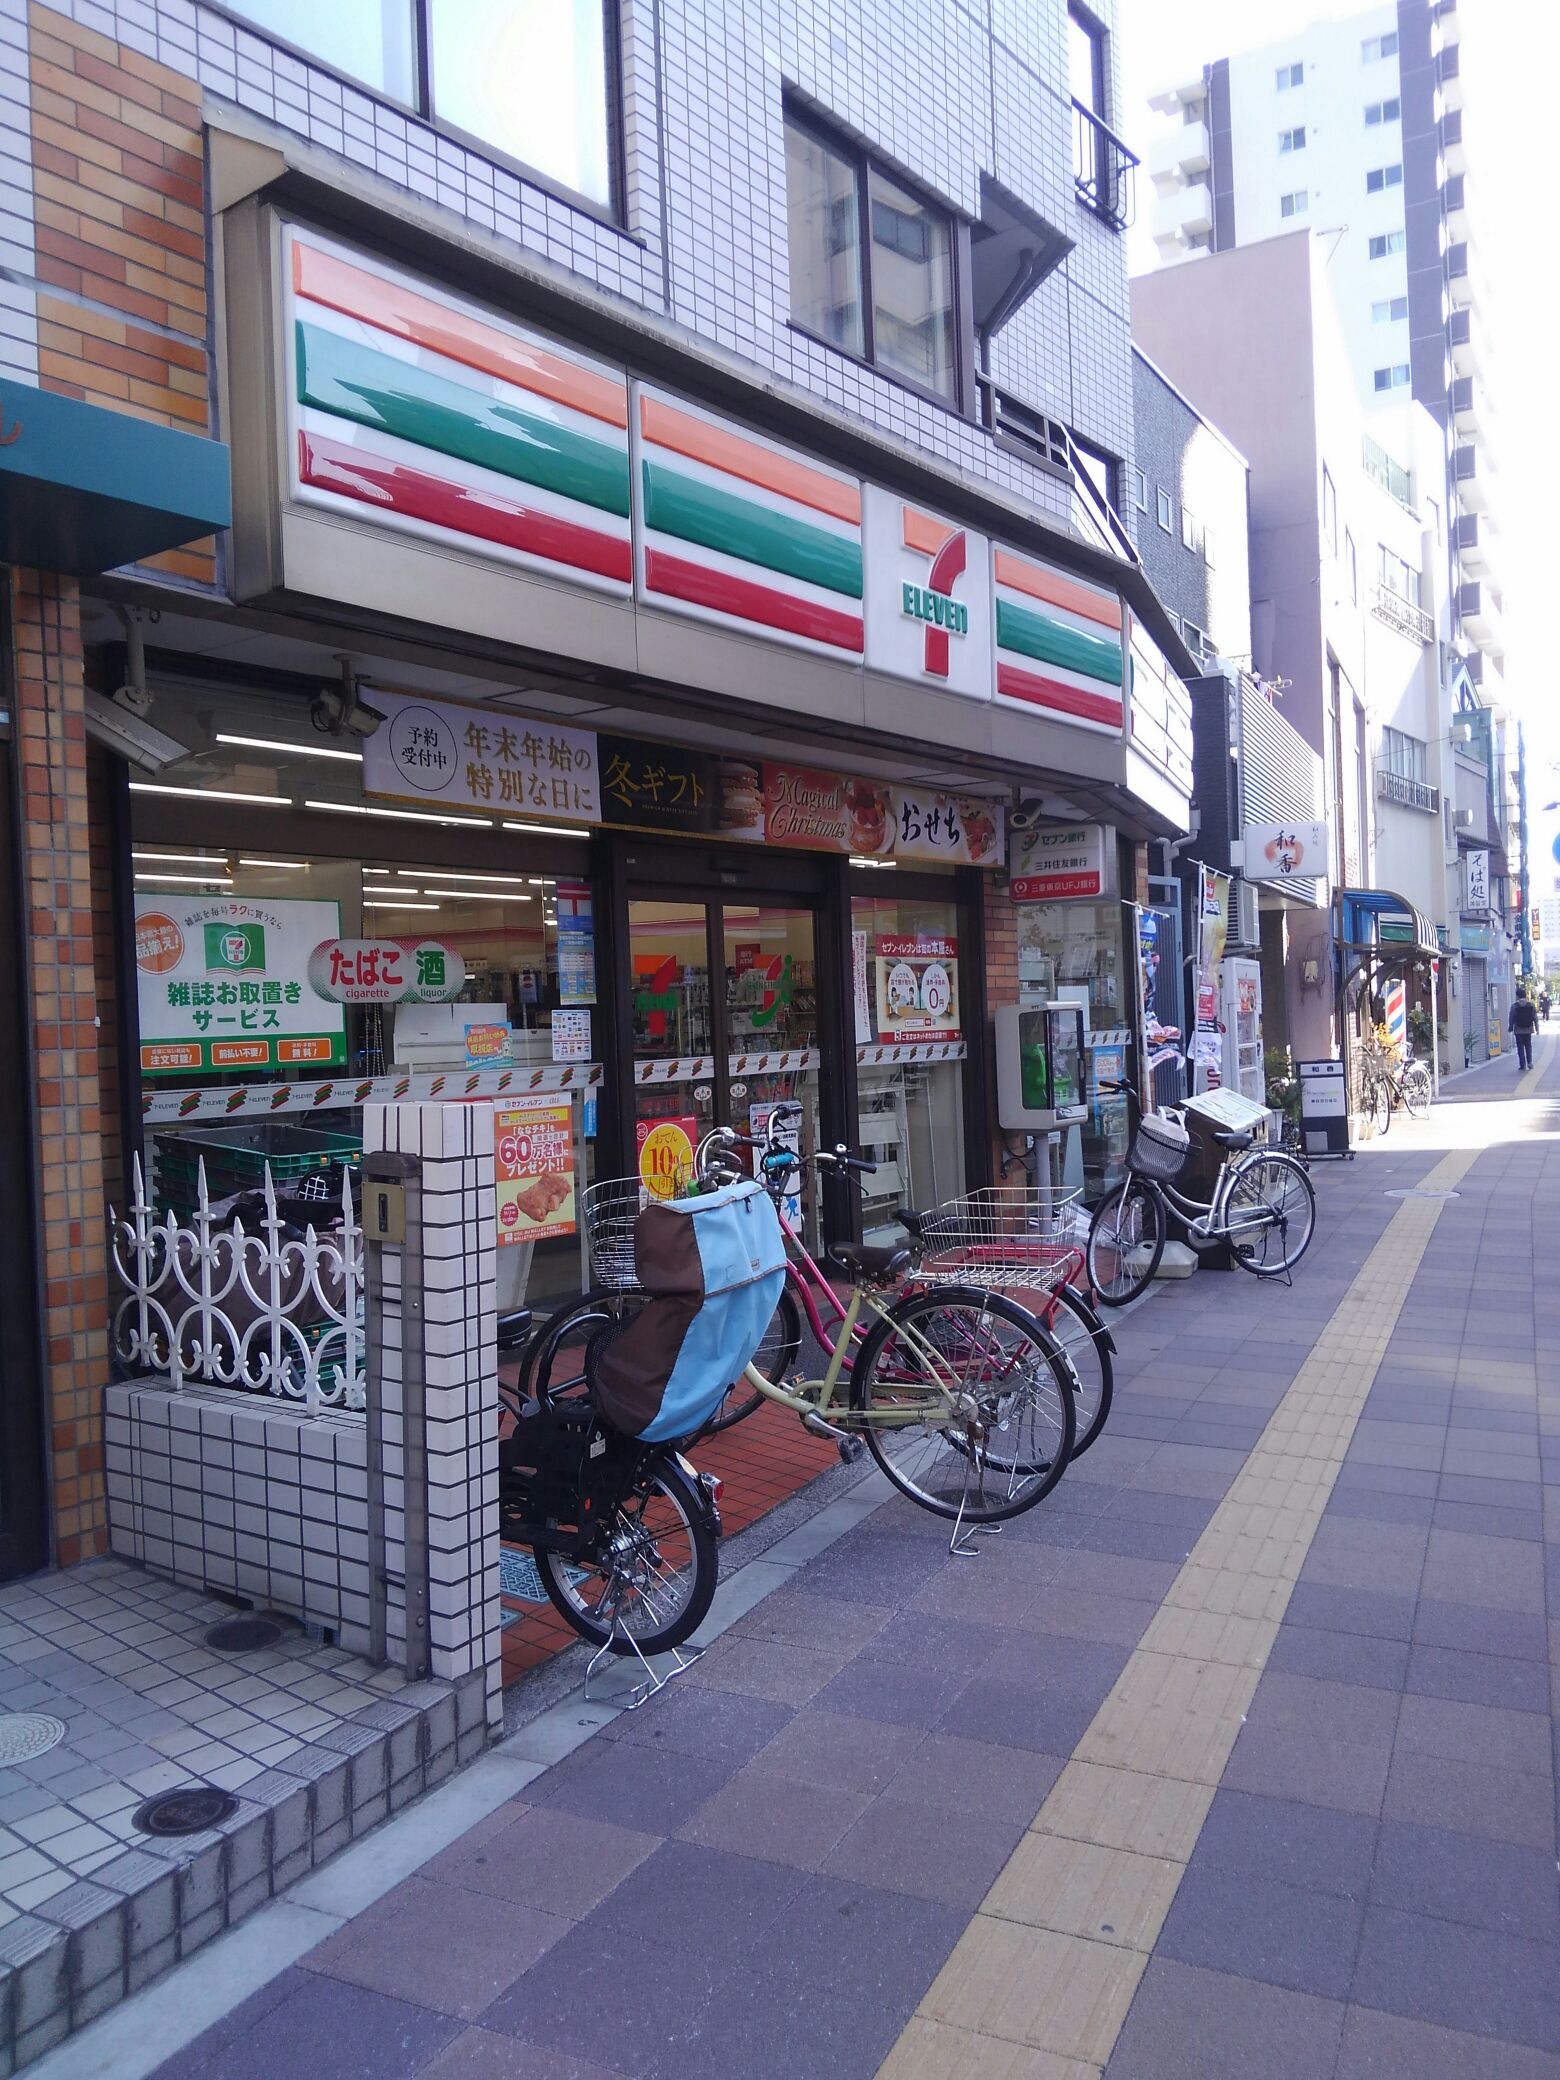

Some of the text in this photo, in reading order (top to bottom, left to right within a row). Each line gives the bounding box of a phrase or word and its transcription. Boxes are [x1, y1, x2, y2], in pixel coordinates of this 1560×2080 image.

[407, 726, 438, 748] 予約
[463, 720, 592, 772] 年末年始の
[401, 747, 447, 770] 受付中
[466, 761, 593, 811] 特別な日に
[603, 753, 705, 808] 冬ギフト
[767, 772, 839, 812] Magical
[770, 803, 848, 839] Christmas
[901, 801, 960, 848] おせち
[1041, 831, 1086, 846] セブン銀行
[1035, 857, 1088, 871] 三井住友銀行
[329, 948, 403, 987] たばこ
[415, 950, 446, 986] 酒
[167, 981, 302, 1007] 雑誌お取置き
[345, 988, 390, 999] cigarette
[420, 988, 447, 999] liquor
[192, 1008, 280, 1032] サービス
[506, 1157, 565, 1178] プレゼント!!
